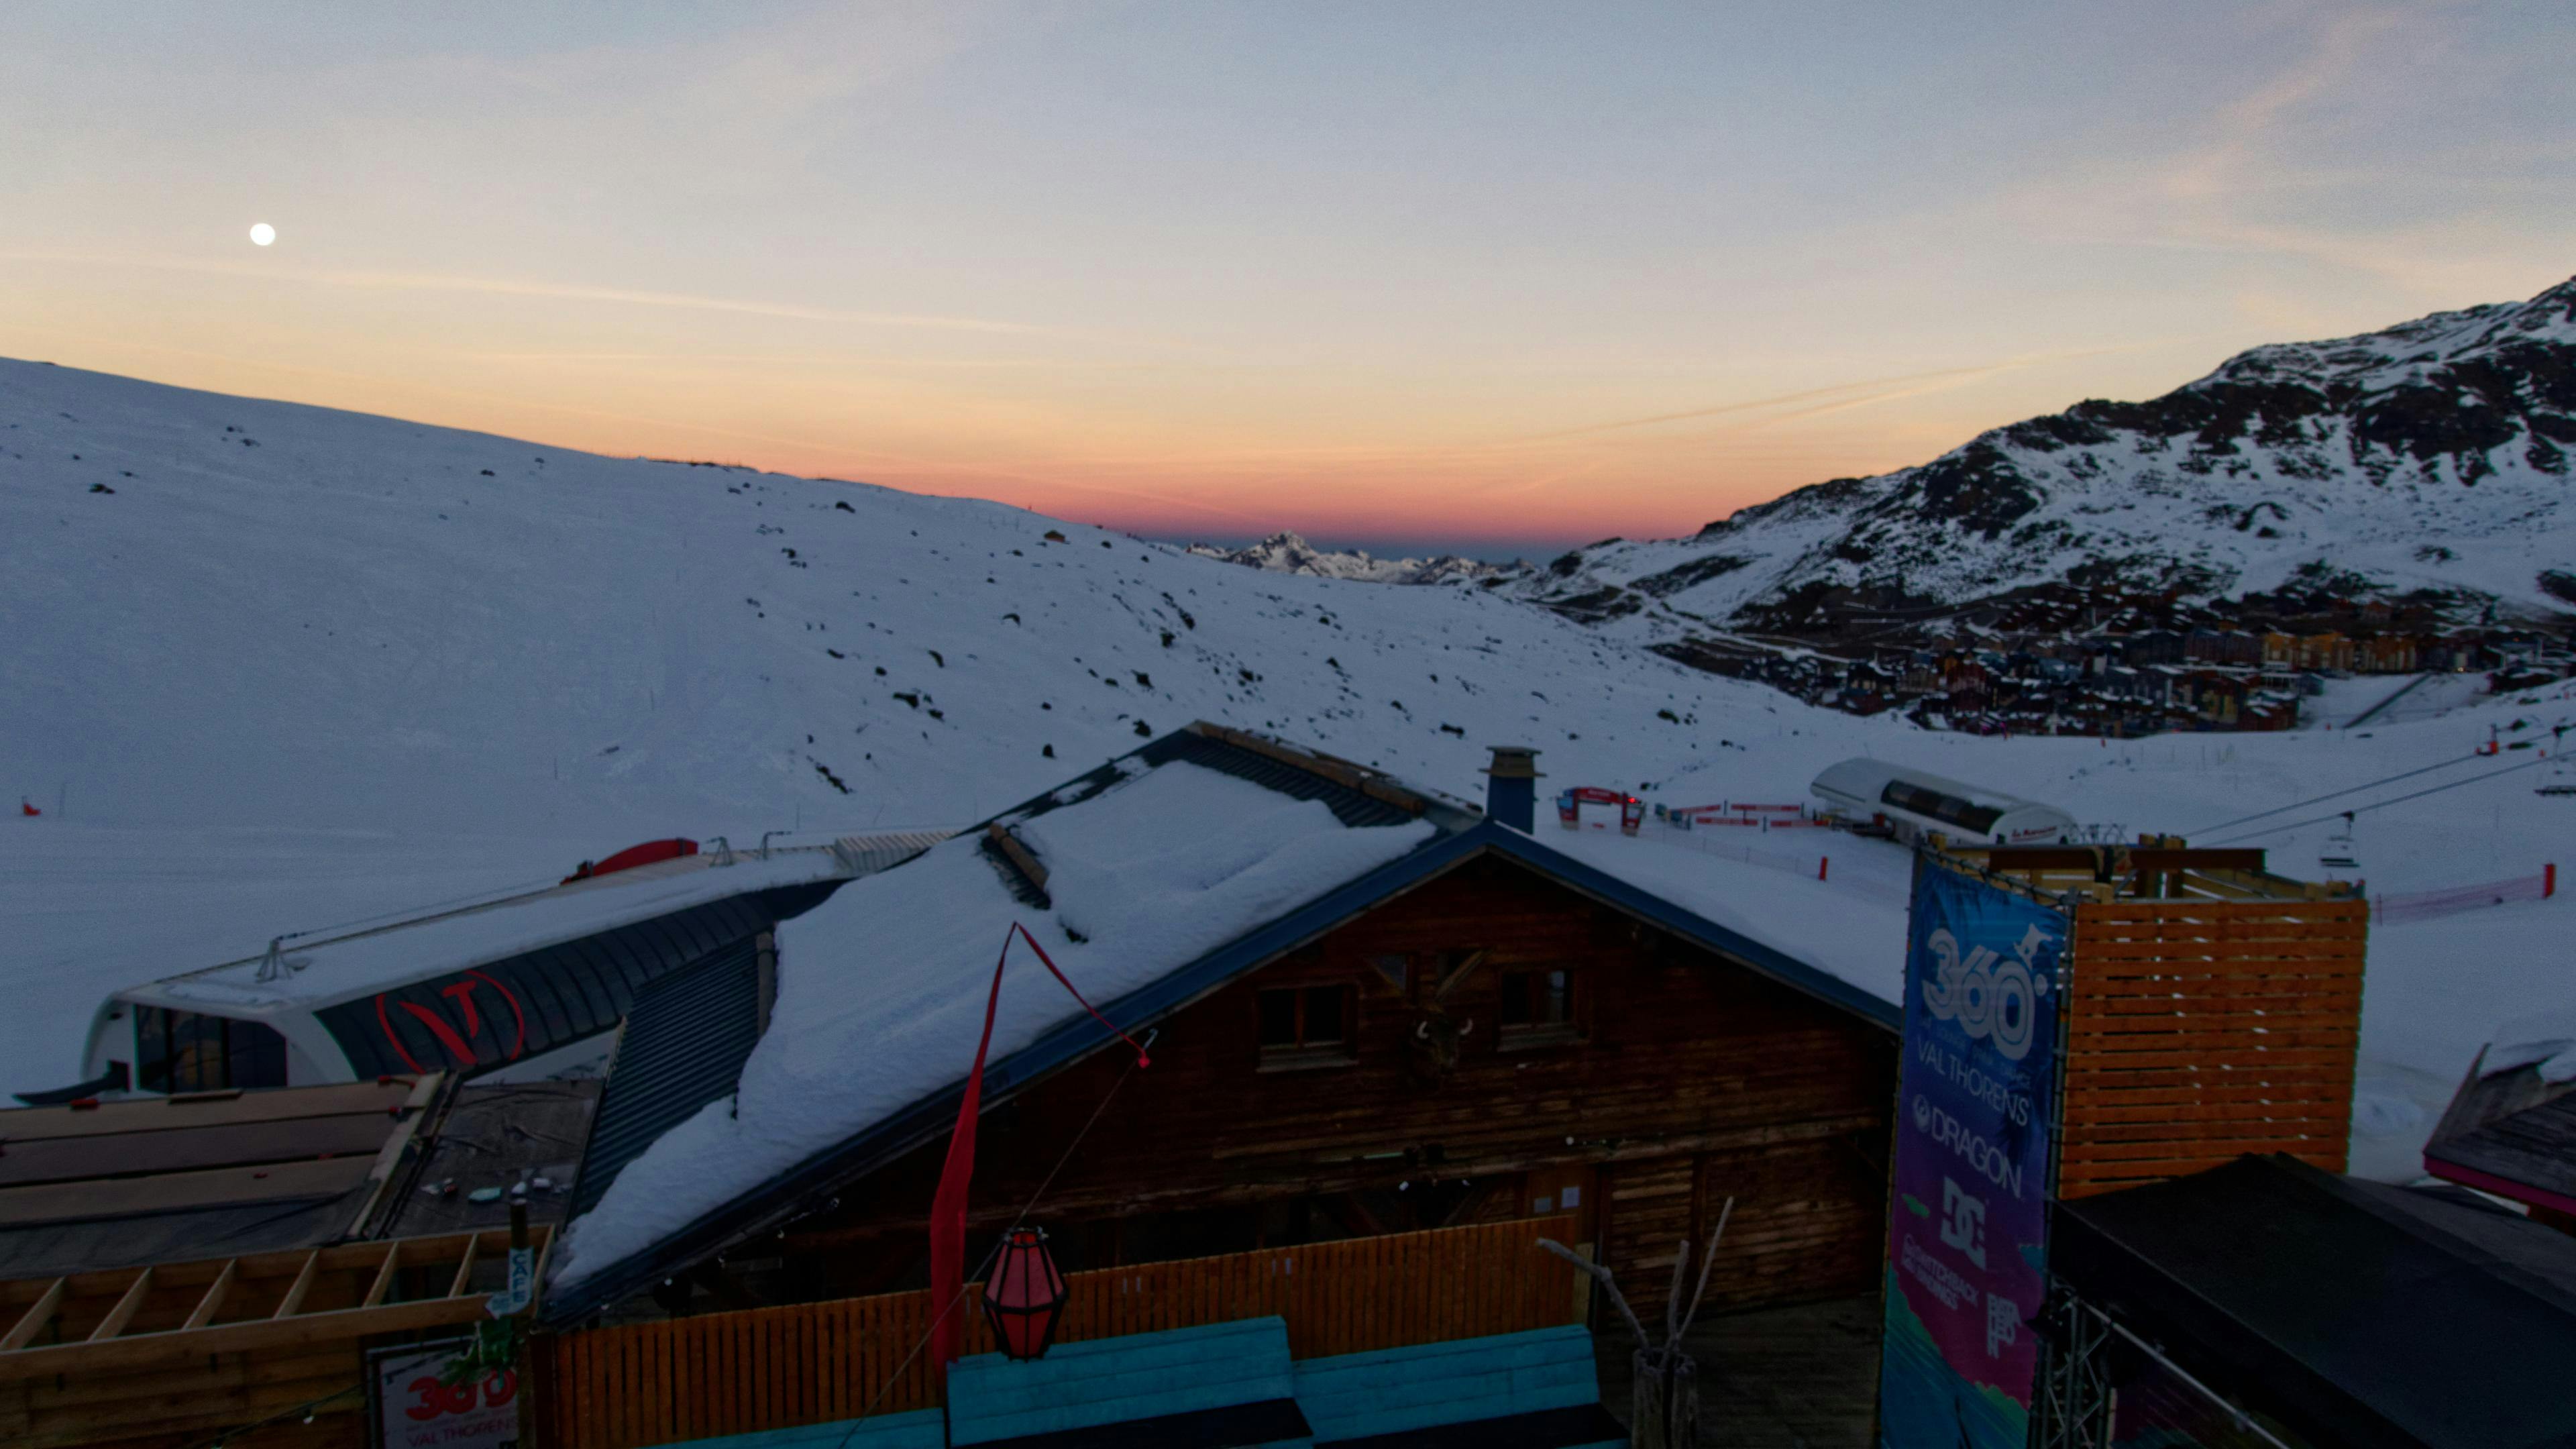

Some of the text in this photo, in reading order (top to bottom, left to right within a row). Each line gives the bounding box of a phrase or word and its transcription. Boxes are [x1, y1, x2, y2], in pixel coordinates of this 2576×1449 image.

[1917, 1034, 1945, 1075] VAL
[1949, 1053, 2030, 1127] THORENS
[1931, 1107, 2022, 1199] DRAGON
[407, 1432, 437, 1447] VAL
